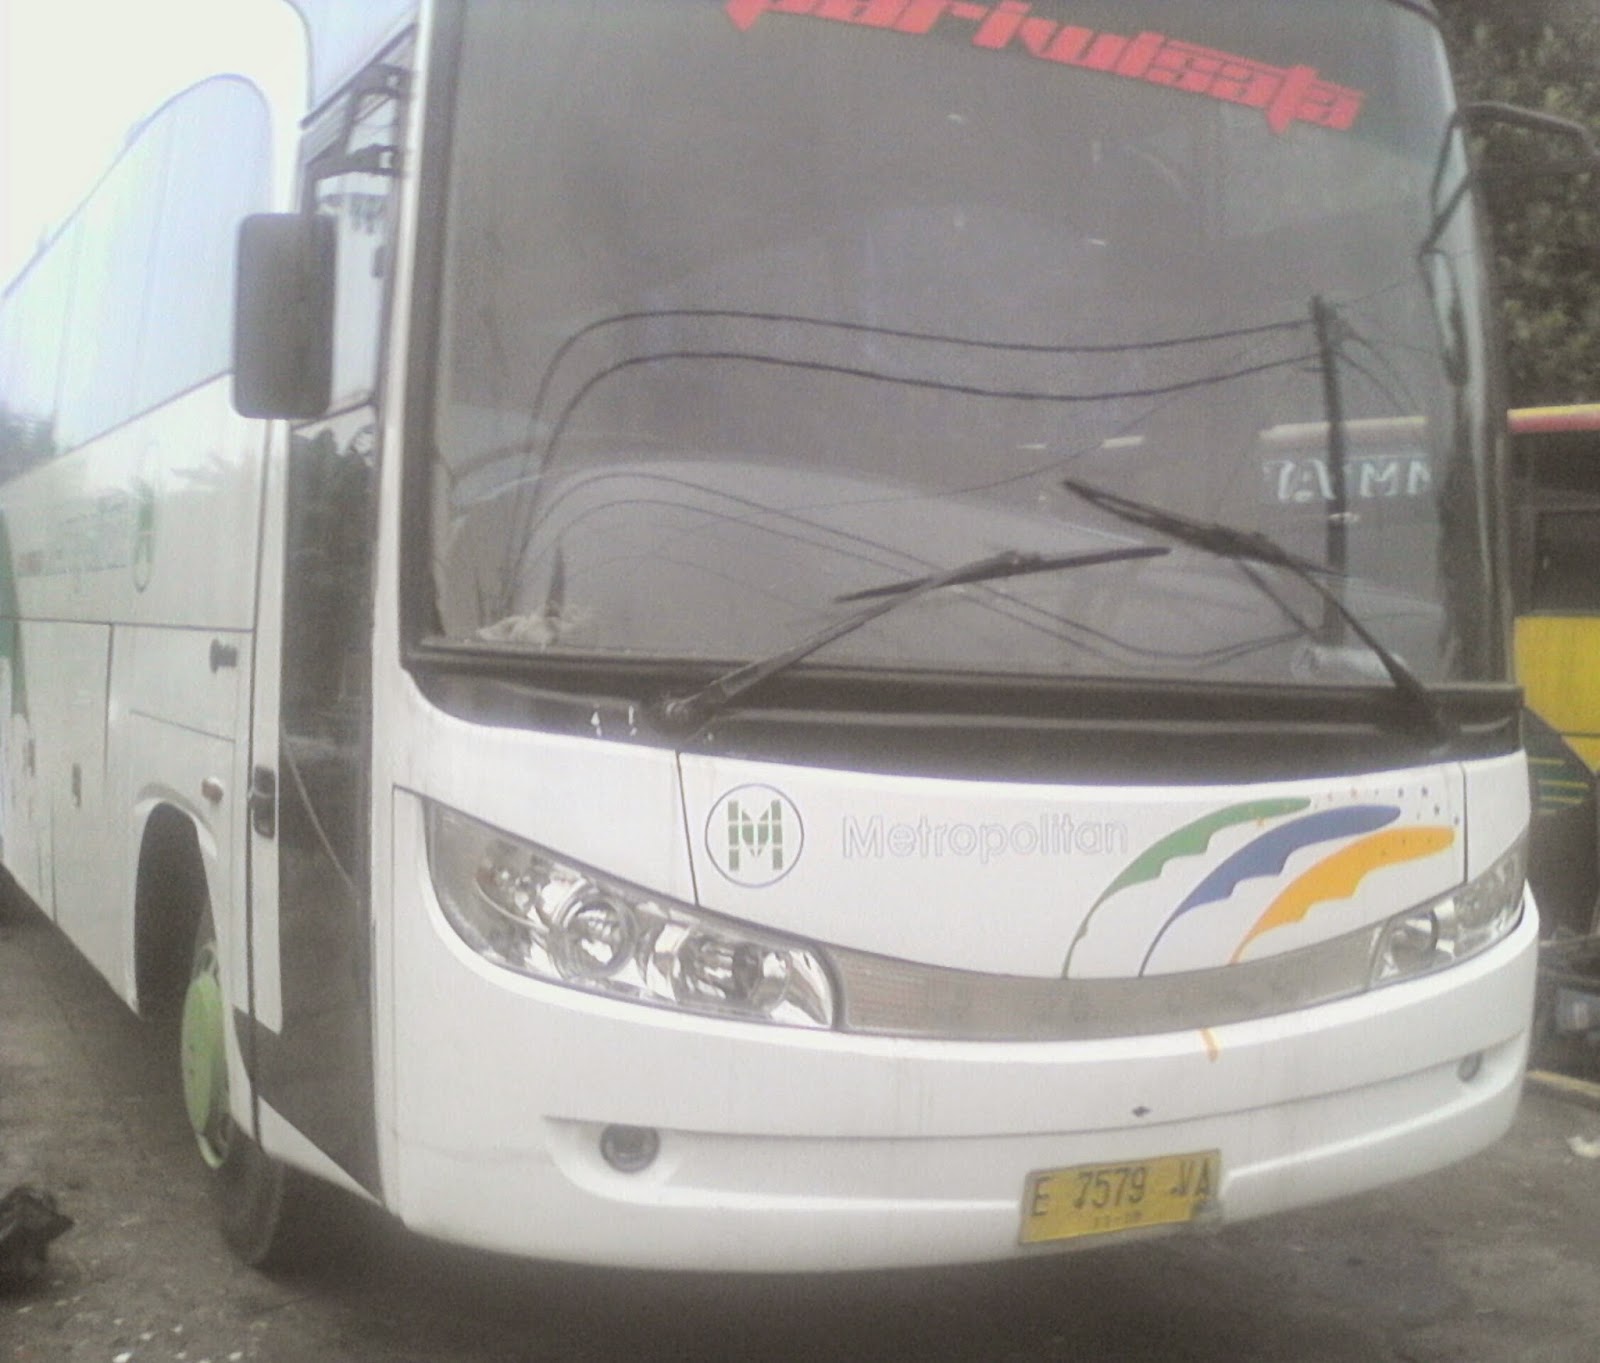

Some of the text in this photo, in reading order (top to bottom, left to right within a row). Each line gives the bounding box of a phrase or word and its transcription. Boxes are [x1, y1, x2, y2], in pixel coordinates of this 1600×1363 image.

[842, 813, 1129, 863] Metropolitan
[1032, 1177, 1050, 1217] E
[1074, 1166, 1147, 1211] 7579
